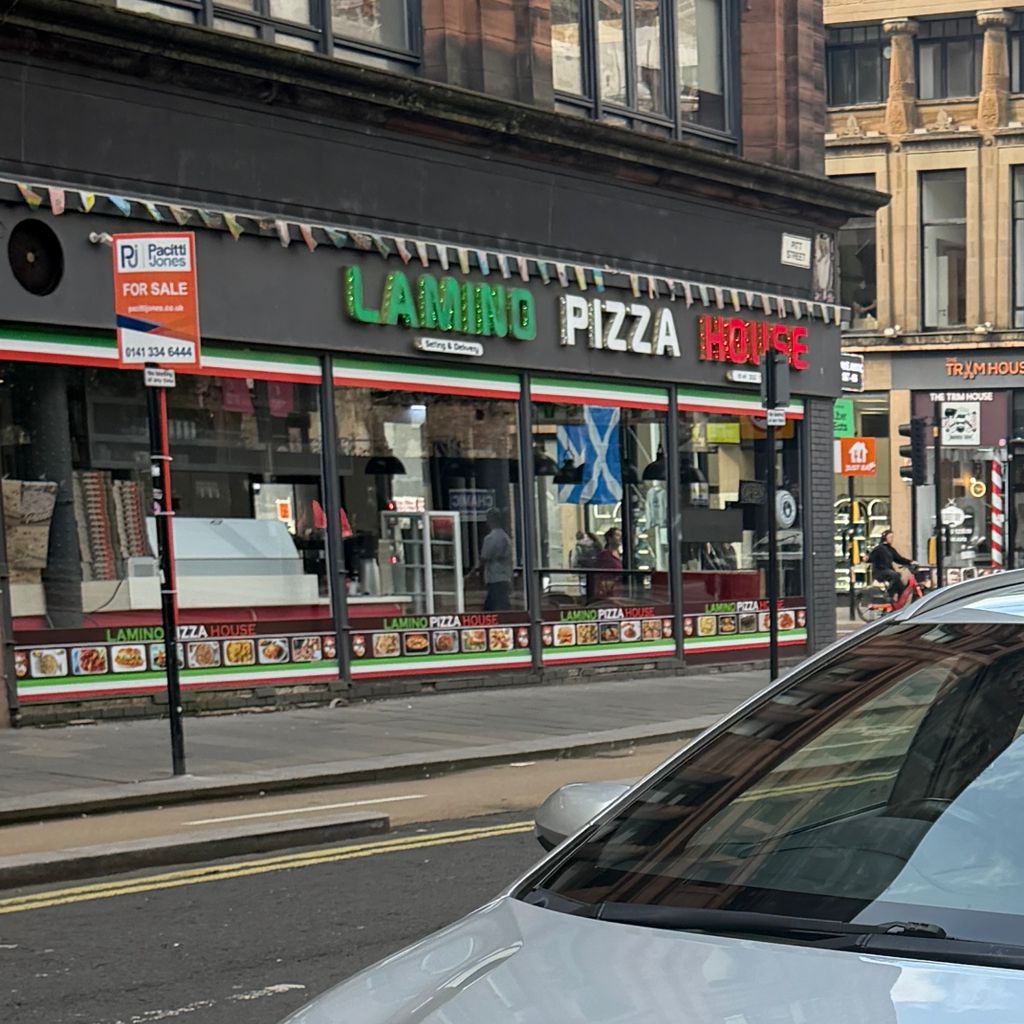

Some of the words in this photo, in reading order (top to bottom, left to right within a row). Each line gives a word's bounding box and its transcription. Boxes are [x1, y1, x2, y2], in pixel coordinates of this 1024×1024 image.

[148, 243, 187, 259] Pacitti
[149, 256, 187, 267] Jones
[122, 283, 148, 297] FOR
[150, 282, 188, 296] SALE
[344, 264, 537, 341] LAMINO
[559, 294, 681, 358] PIZZA
[699, 315, 810, 370] HOUSE
[125, 347, 146, 358] 0141
[147, 346, 166, 357] 334
[168, 346, 192, 357] 6444
[930, 392, 945, 401] THE
[946, 392, 966, 401] TRIM
[966, 391, 993, 401] HOUSE
[560, 608, 598, 621] LAMINO
[598, 608, 624, 619] PIZZA
[625, 606, 655, 617] HOUSE
[704, 601, 736, 614] LAMINO
[737, 600, 759, 612] PIZZA
[383, 616, 428, 630] LAMINO
[429, 615, 461, 628] PIZZA
[462, 614, 498, 626] HOUSE
[106, 627, 165, 643] LAMINO
[175, 625, 208, 639] IZZA
[210, 623, 257, 637] HOUSE
